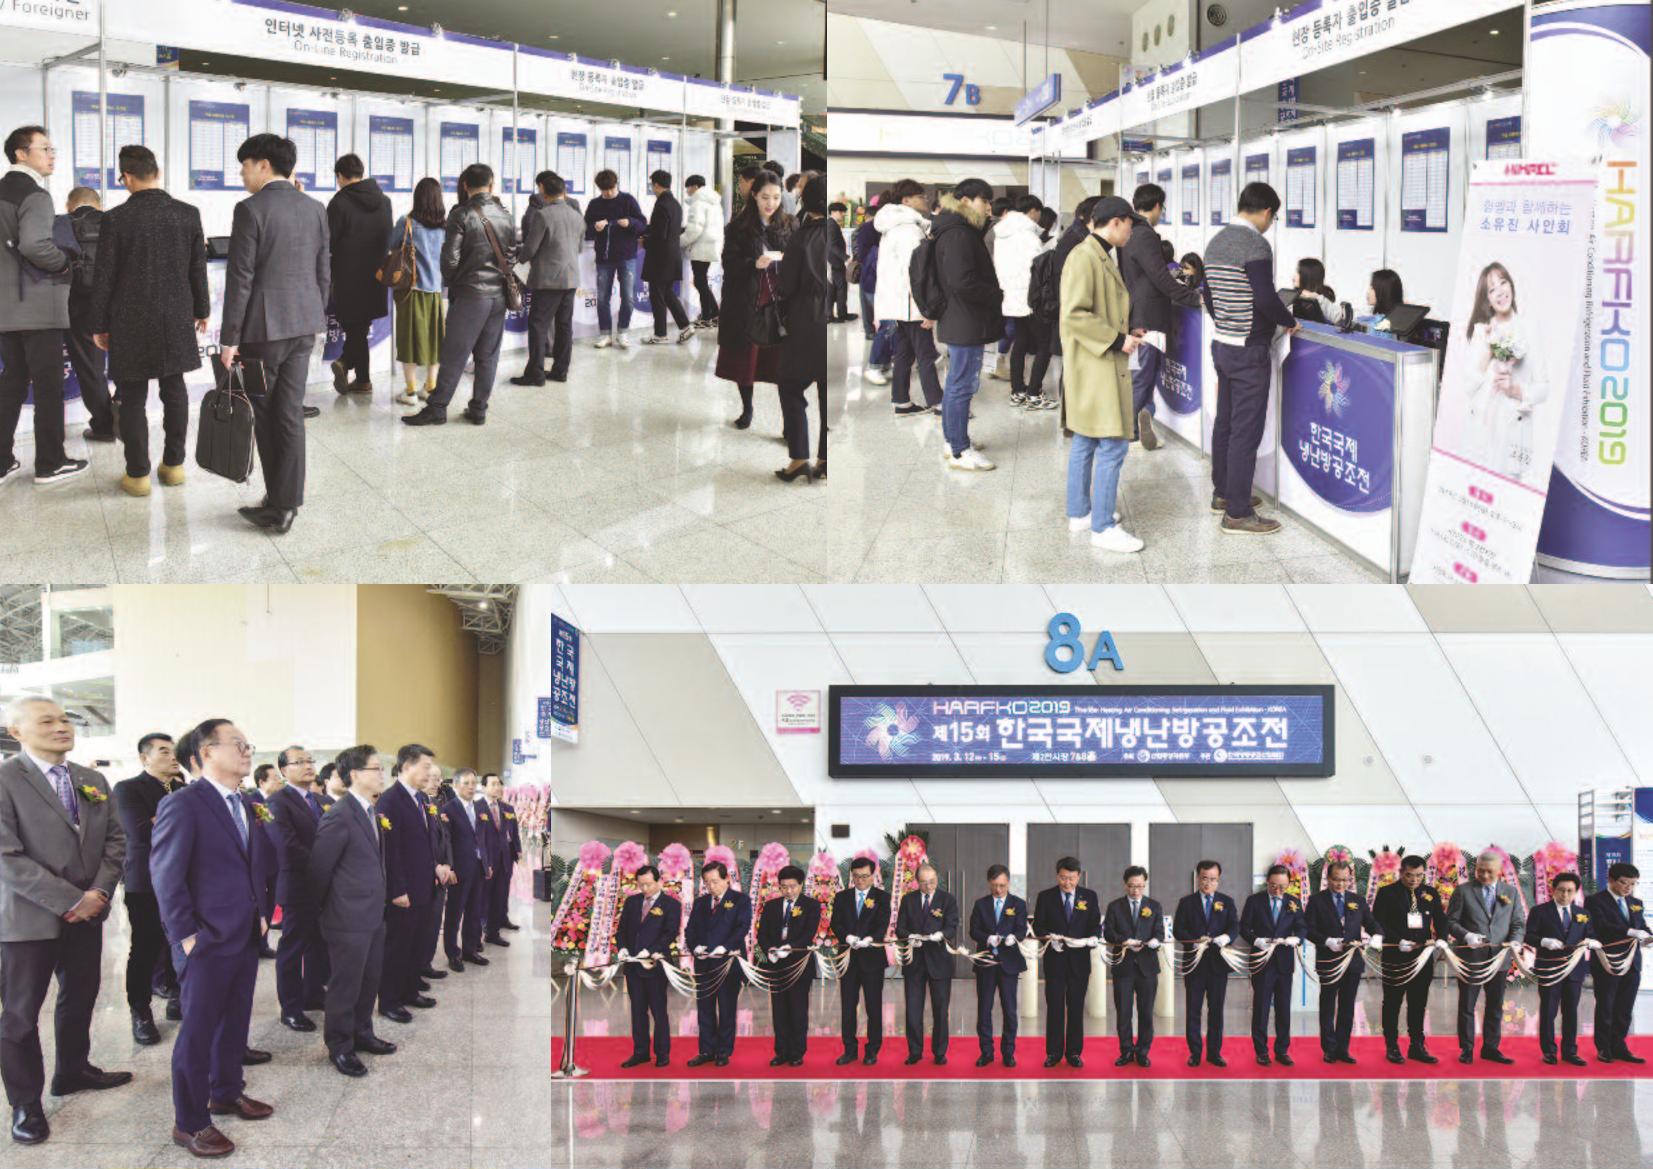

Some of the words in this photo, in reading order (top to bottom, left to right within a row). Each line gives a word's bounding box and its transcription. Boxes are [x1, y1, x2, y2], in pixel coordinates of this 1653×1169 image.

[13, 0, 89, 20] Foreigner
[265, 18, 304, 39] 인터넷
[309, 25, 358, 47] 사전등록
[362, 33, 396, 53] 출입증
[400, 40, 421, 56] 발급
[339, 47, 398, 64] Registration
[1480, 217, 1519, 233] 소유진
[1527, 219, 1571, 235] 사인회
[1310, 422, 1359, 464] 한국국제
[1298, 438, 1370, 495] 냉난방공조전
[1043, 612, 1125, 674] 8A
[932, 721, 991, 744] 제15회
[996, 717, 1288, 750] 한국국제냉난방공조전
